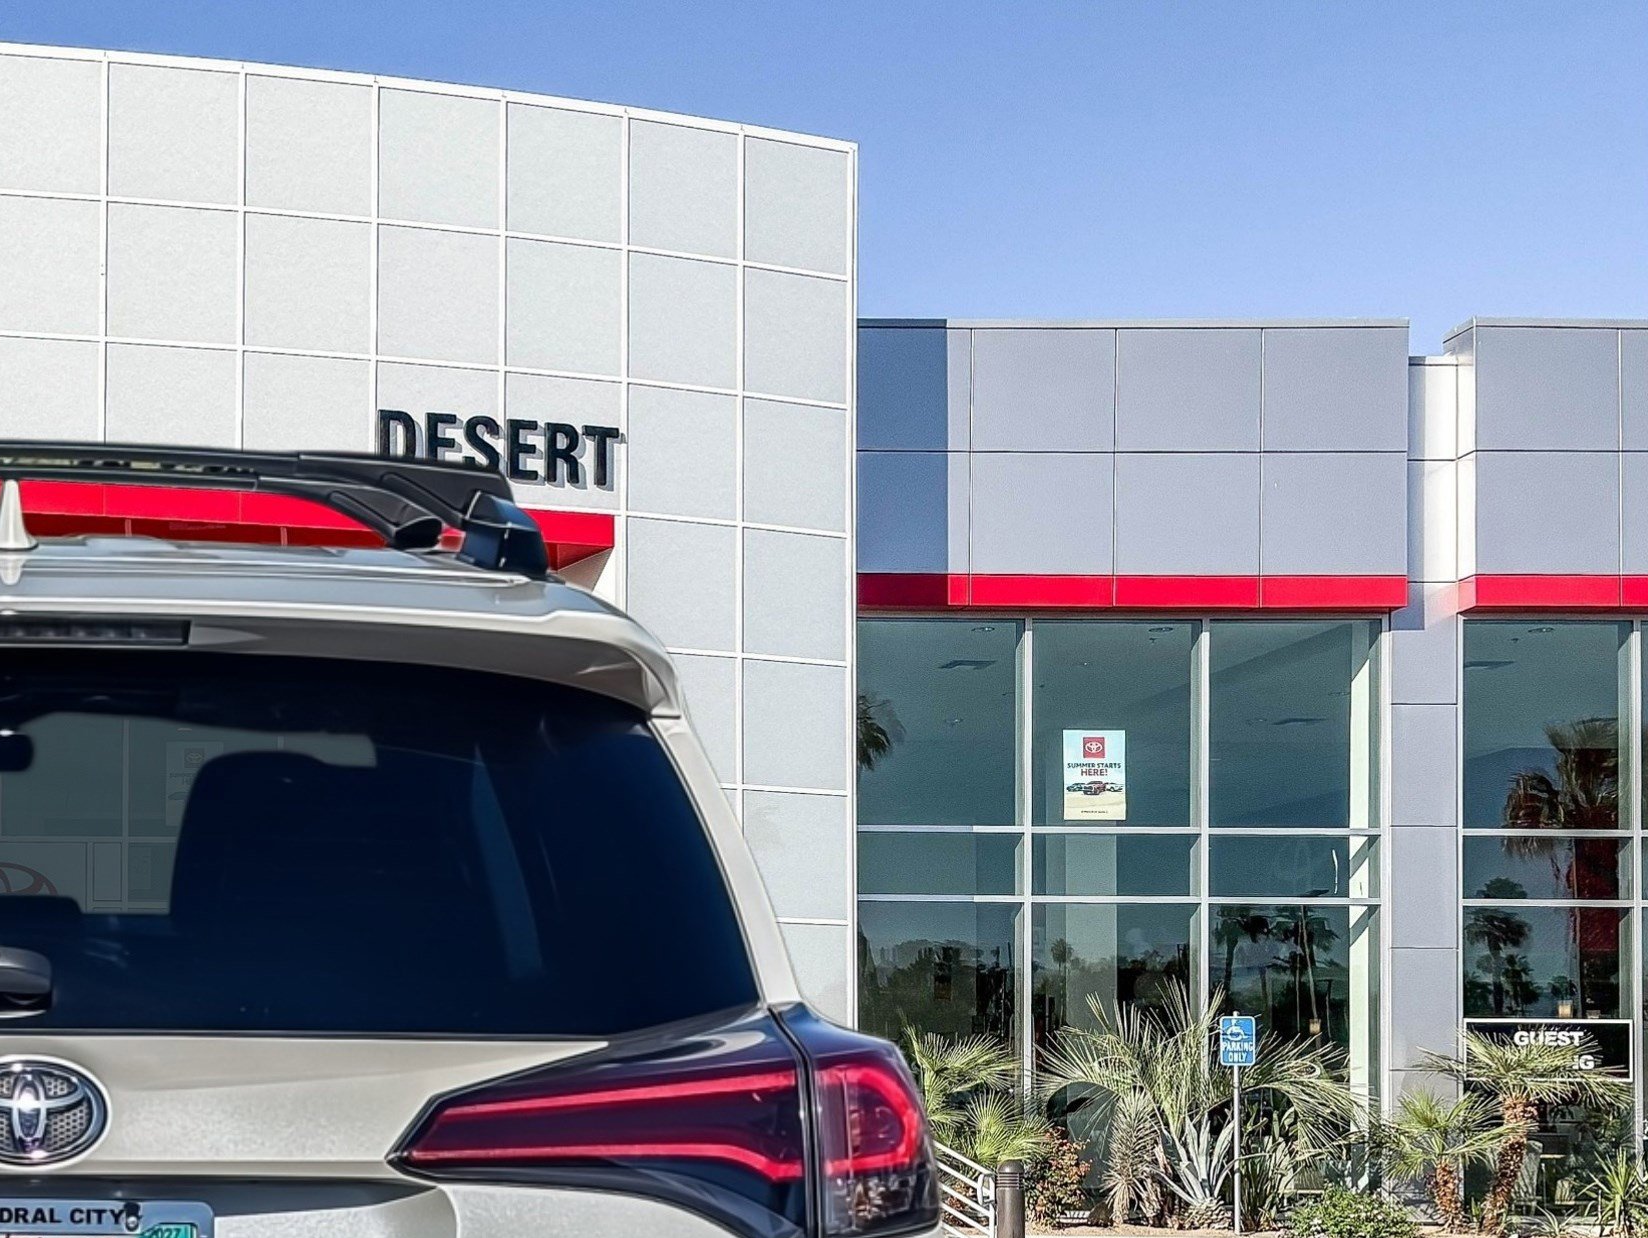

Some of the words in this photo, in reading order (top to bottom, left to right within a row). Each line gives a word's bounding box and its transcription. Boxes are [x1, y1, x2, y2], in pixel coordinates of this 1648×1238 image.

[377, 409, 620, 488] DESERT
[1222, 1041, 1254, 1051] PARKING
[1513, 1030, 1584, 1047] GUEST
[1228, 1051, 1247, 1062] ONLY
[69, 1207, 126, 1224] CITY
